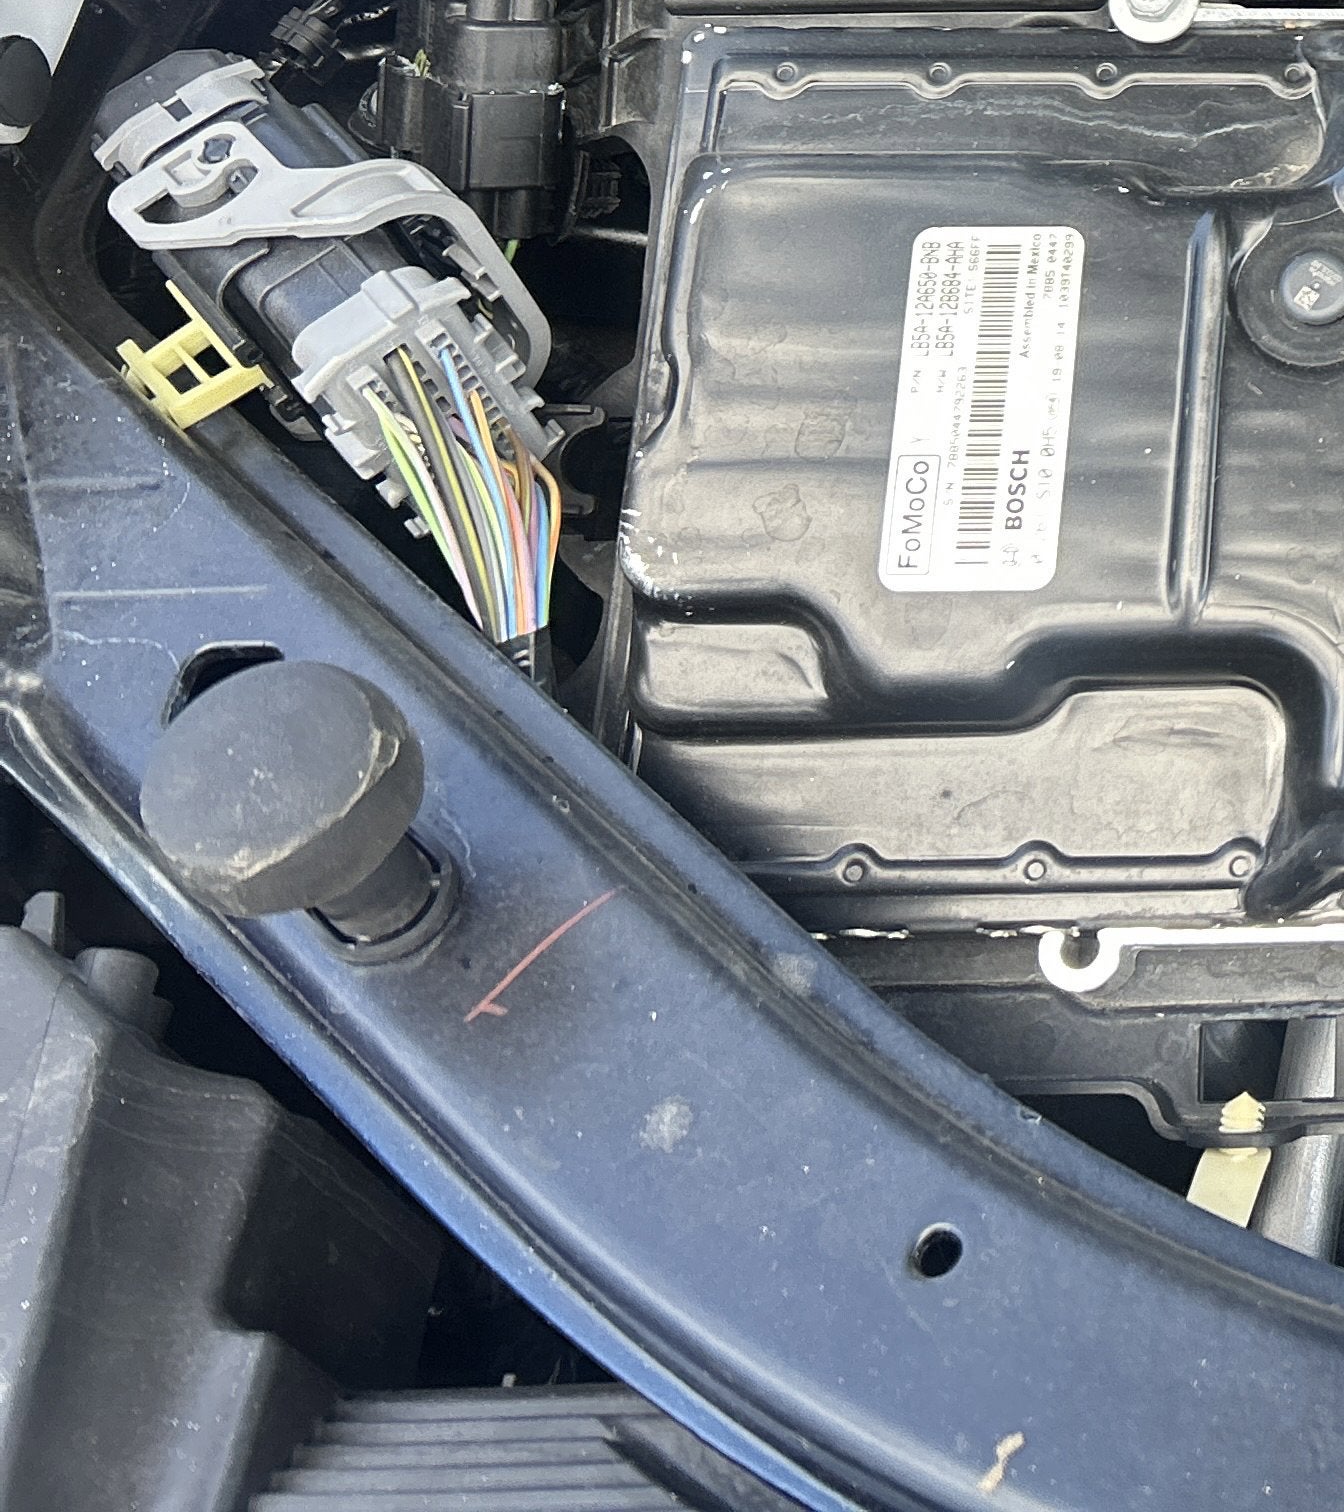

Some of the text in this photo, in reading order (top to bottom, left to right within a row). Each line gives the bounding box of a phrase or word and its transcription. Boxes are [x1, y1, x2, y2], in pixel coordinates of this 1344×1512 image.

[1026, 233, 1042, 275] Mexico
[934, 241, 965, 357] LB5A-12B684-AHA
[1018, 292, 1037, 358] Assembled
[910, 369, 922, 393] P/N
[897, 460, 930, 569] FoMoCo
[942, 481, 955, 506] SN
[1004, 449, 1031, 530] BOSCH
